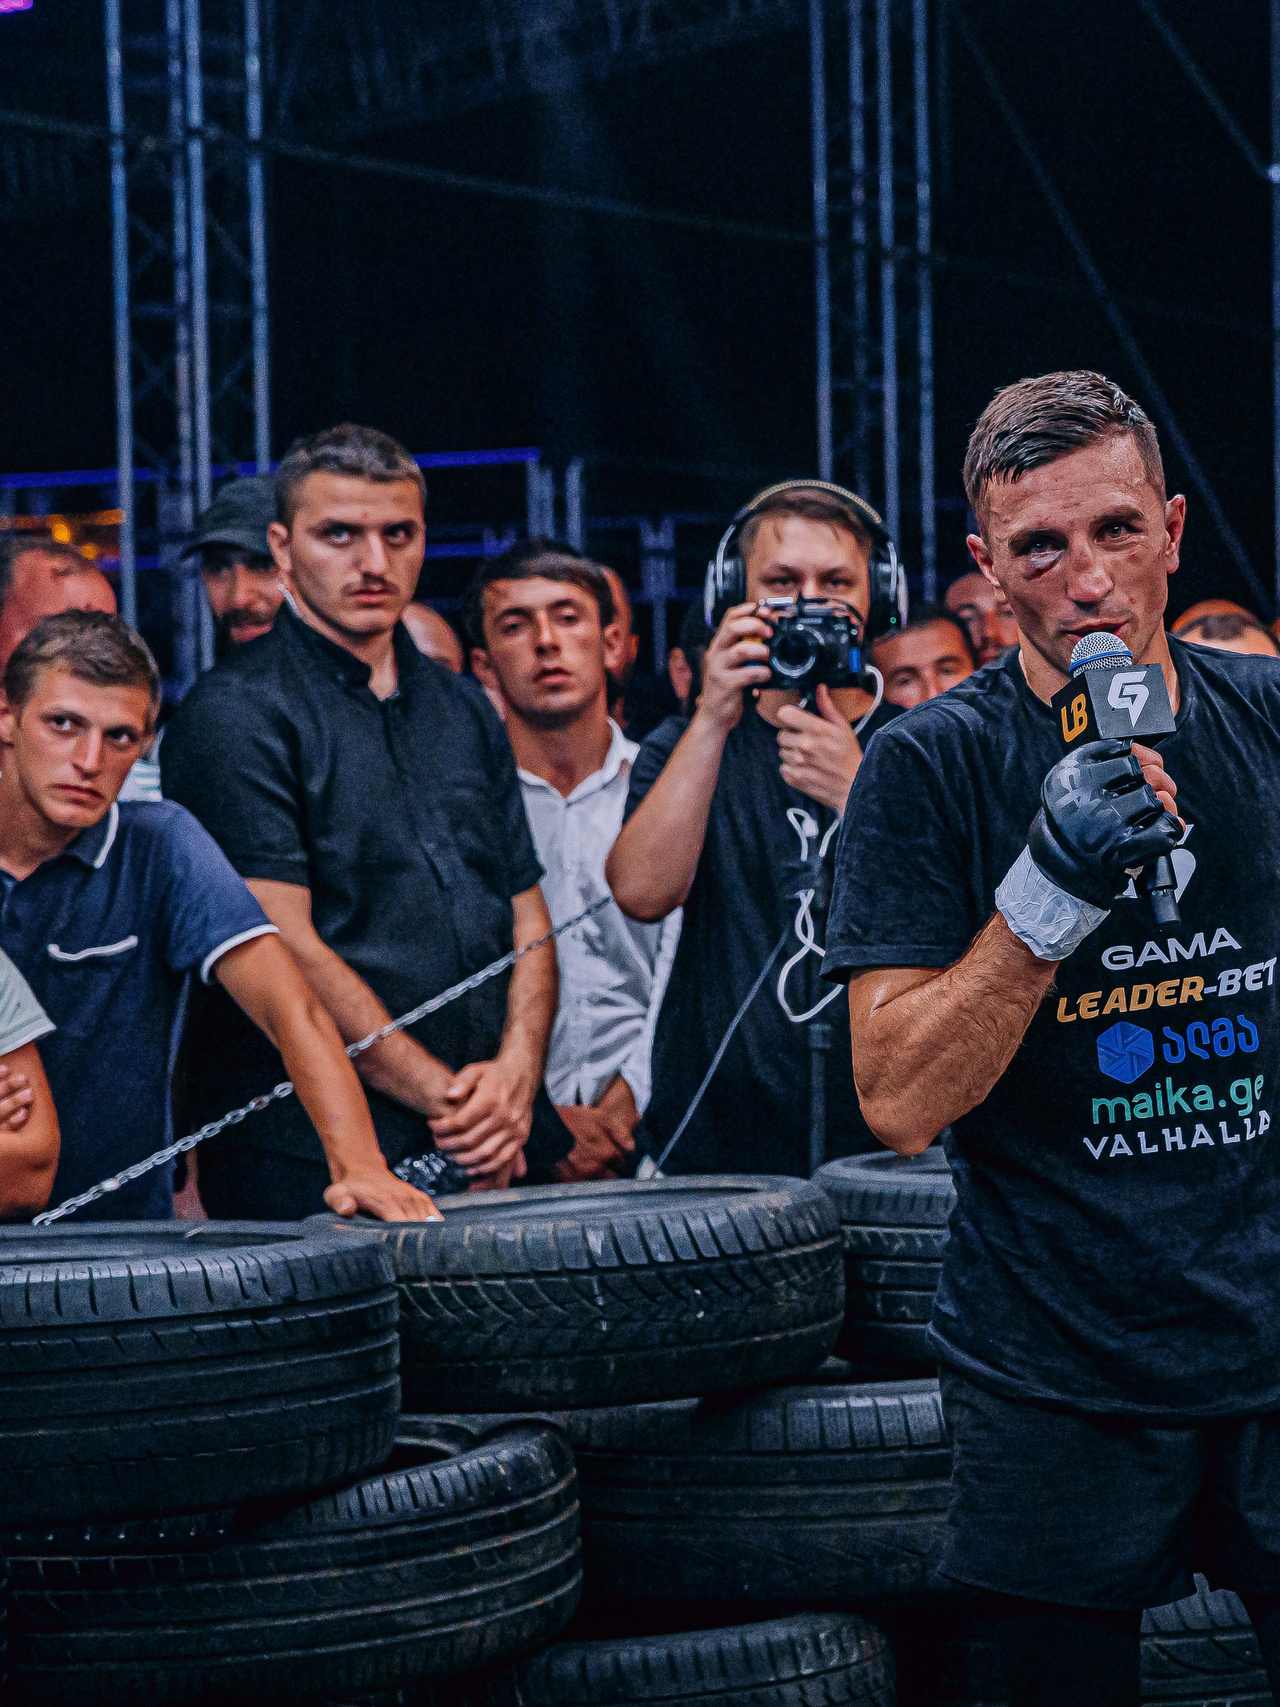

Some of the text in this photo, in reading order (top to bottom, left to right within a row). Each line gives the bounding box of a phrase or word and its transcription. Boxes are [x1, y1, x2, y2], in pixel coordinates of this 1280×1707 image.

[1061, 693, 1088, 742] LB
[1101, 928, 1242, 971] GAMA
[1056, 957, 1278, 1023] LEADER-BET
[1092, 1074, 1264, 1124] maika.ge
[1083, 1111, 1271, 1159] VALHALLA
